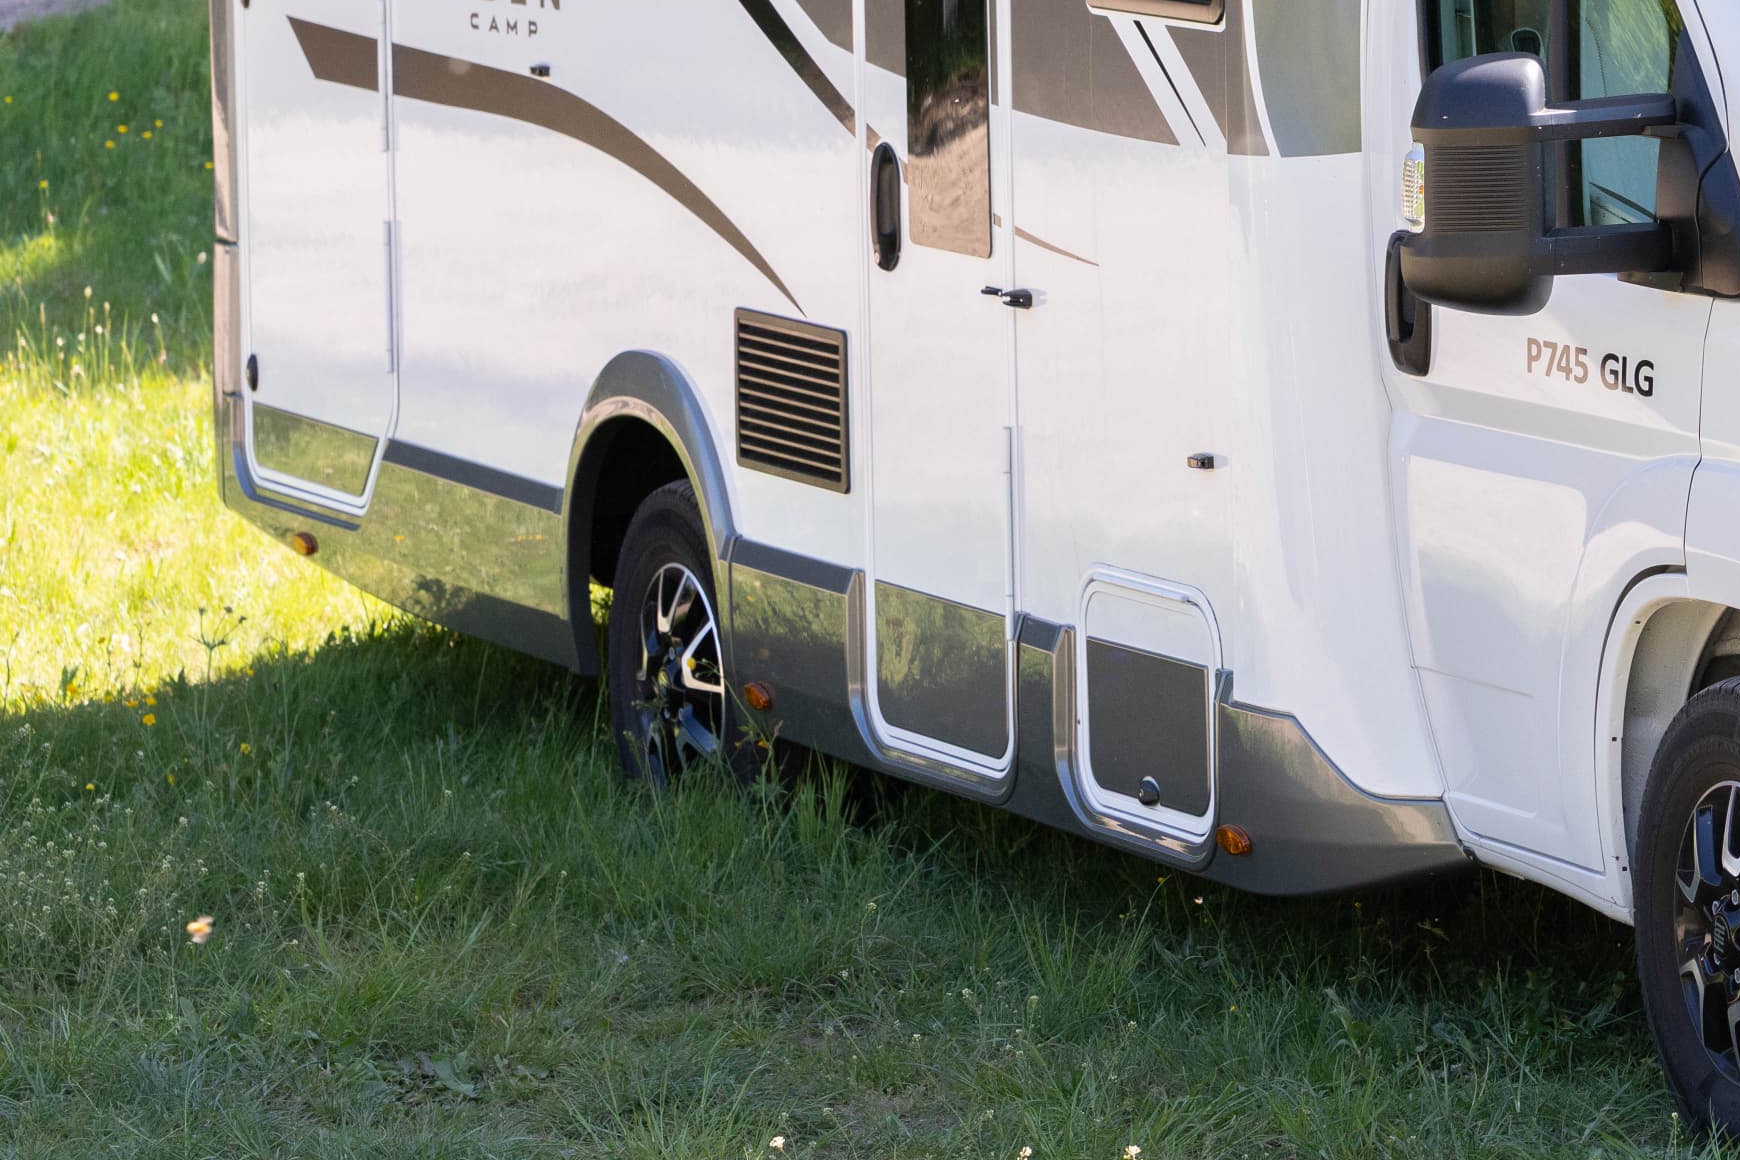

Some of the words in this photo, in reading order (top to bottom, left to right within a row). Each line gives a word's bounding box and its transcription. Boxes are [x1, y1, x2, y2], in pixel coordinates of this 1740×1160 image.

[469, 12, 539, 38] CAMP
[1527, 337, 1588, 384] P745
[1600, 352, 1655, 397] GLG
